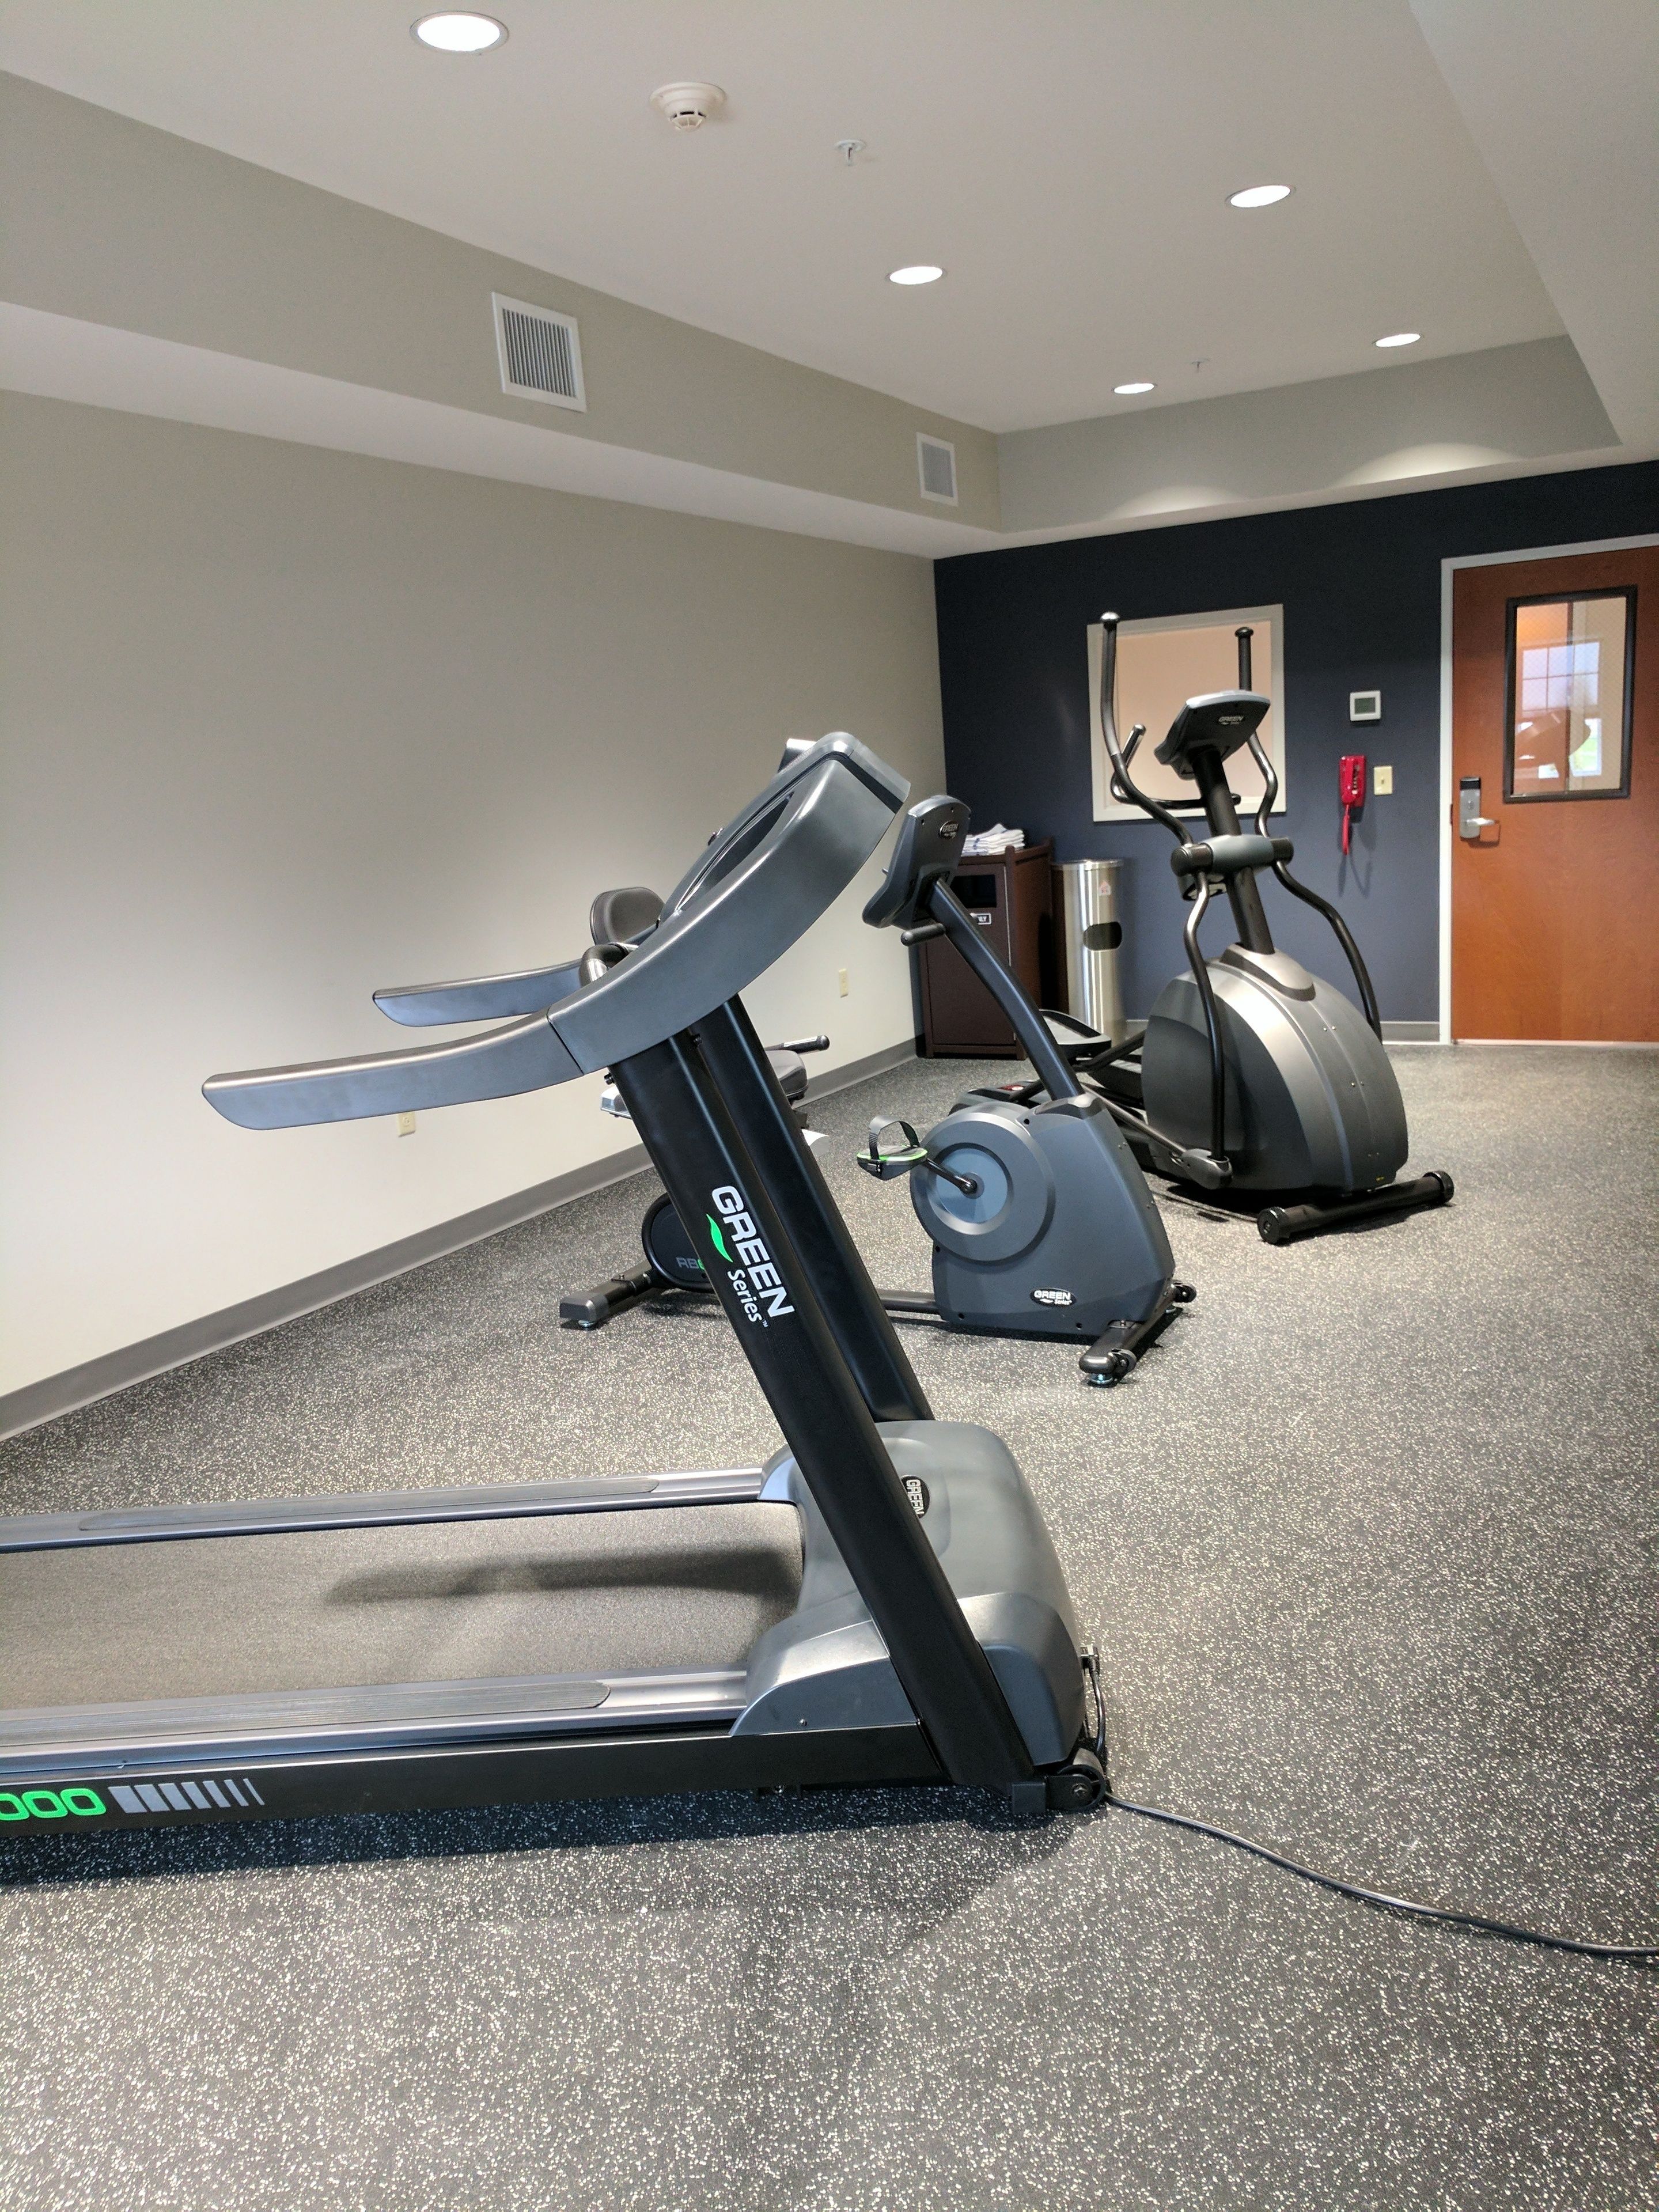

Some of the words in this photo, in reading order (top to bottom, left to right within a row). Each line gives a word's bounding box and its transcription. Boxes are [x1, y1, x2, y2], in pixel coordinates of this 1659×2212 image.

[712, 1185, 795, 1317] GREEN
[1034, 1290, 1071, 1300] GREEN
[906, 1479, 925, 1514] GREEN
